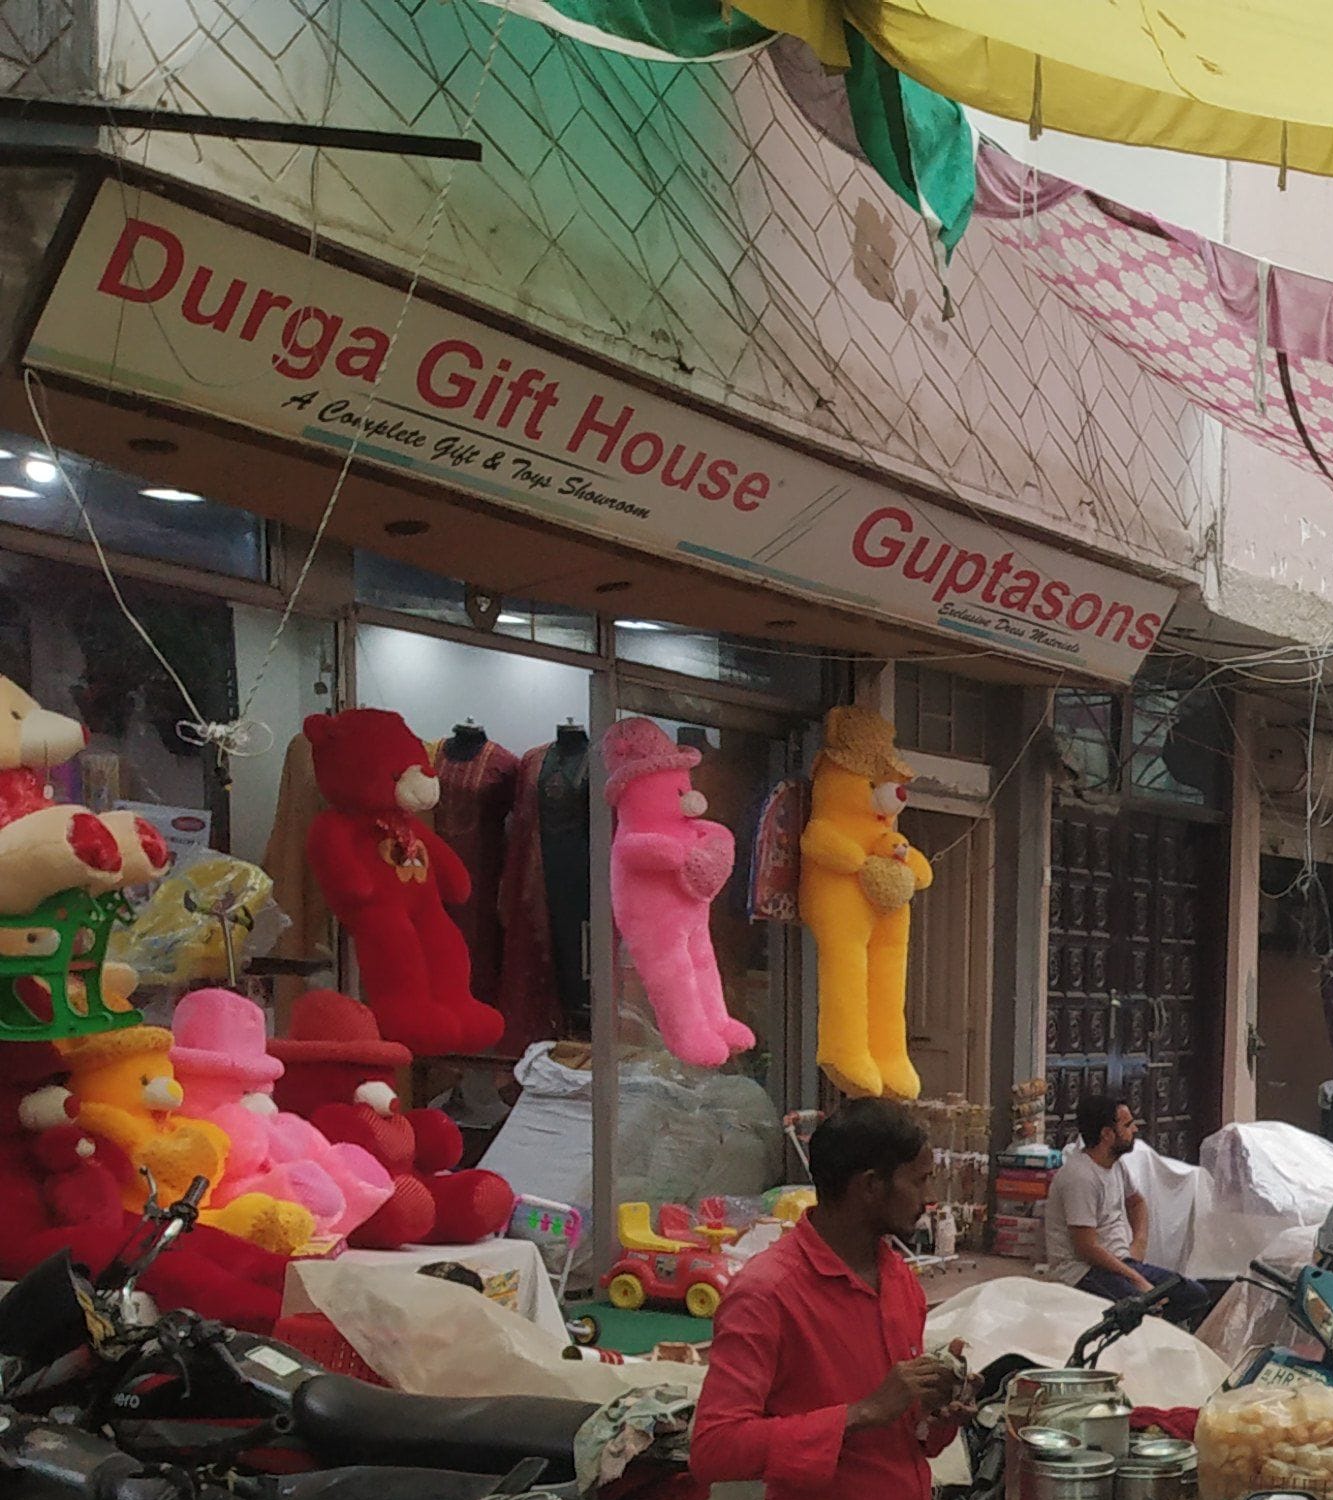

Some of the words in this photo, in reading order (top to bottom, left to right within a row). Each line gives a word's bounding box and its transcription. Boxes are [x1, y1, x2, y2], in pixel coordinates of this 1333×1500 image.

[97, 218, 391, 383] Durga
[416, 340, 560, 440] Gift
[566, 394, 770, 511] House
[282, 391, 319, 410] A
[432, 436, 474, 466] Gift
[482, 452, 506, 470] &
[512, 458, 552, 489] Toys
[557, 476, 651, 520] Showroom
[852, 507, 1162, 650] Guptasons
[938, 602, 991, 626] Exclusive
[994, 619, 1026, 637] Dress
